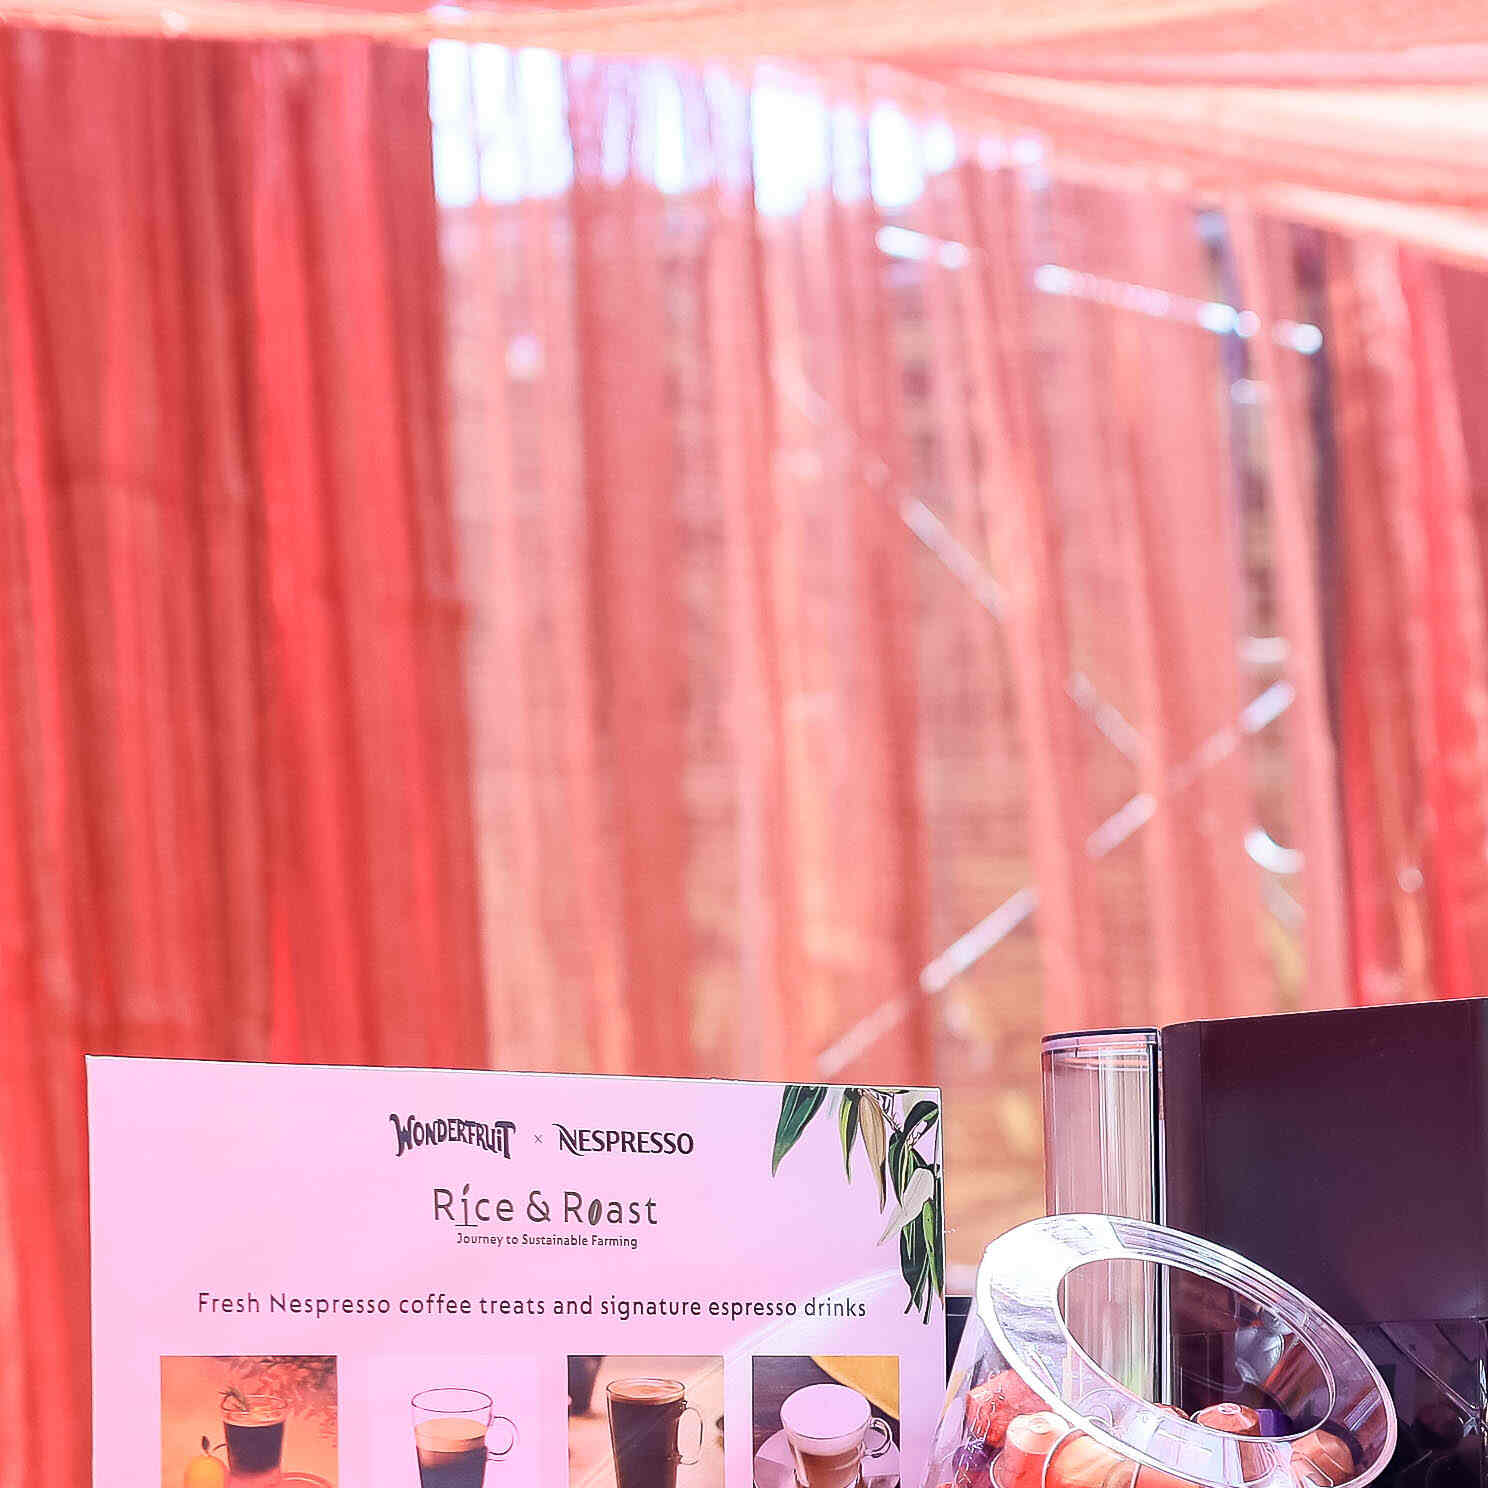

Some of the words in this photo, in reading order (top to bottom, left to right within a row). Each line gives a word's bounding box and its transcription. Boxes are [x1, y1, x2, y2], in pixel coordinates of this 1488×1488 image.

[552, 1123, 694, 1156] NESPRESSO
[433, 1184, 514, 1227] Rice
[527, 1190, 551, 1223] &
[563, 1192, 658, 1225] Roast
[456, 1232, 503, 1247] Journey
[506, 1235, 519, 1245] to
[522, 1233, 588, 1246] Sustainable
[591, 1235, 638, 1249] Farming
[198, 1292, 259, 1313] Fresh
[270, 1293, 390, 1318] Nespresso
[399, 1294, 472, 1314] coffee
[480, 1298, 545, 1315] treats
[553, 1295, 592, 1315] and
[601, 1295, 701, 1320] signature
[708, 1301, 797, 1321] espresso
[804, 1297, 866, 1317] drinks
